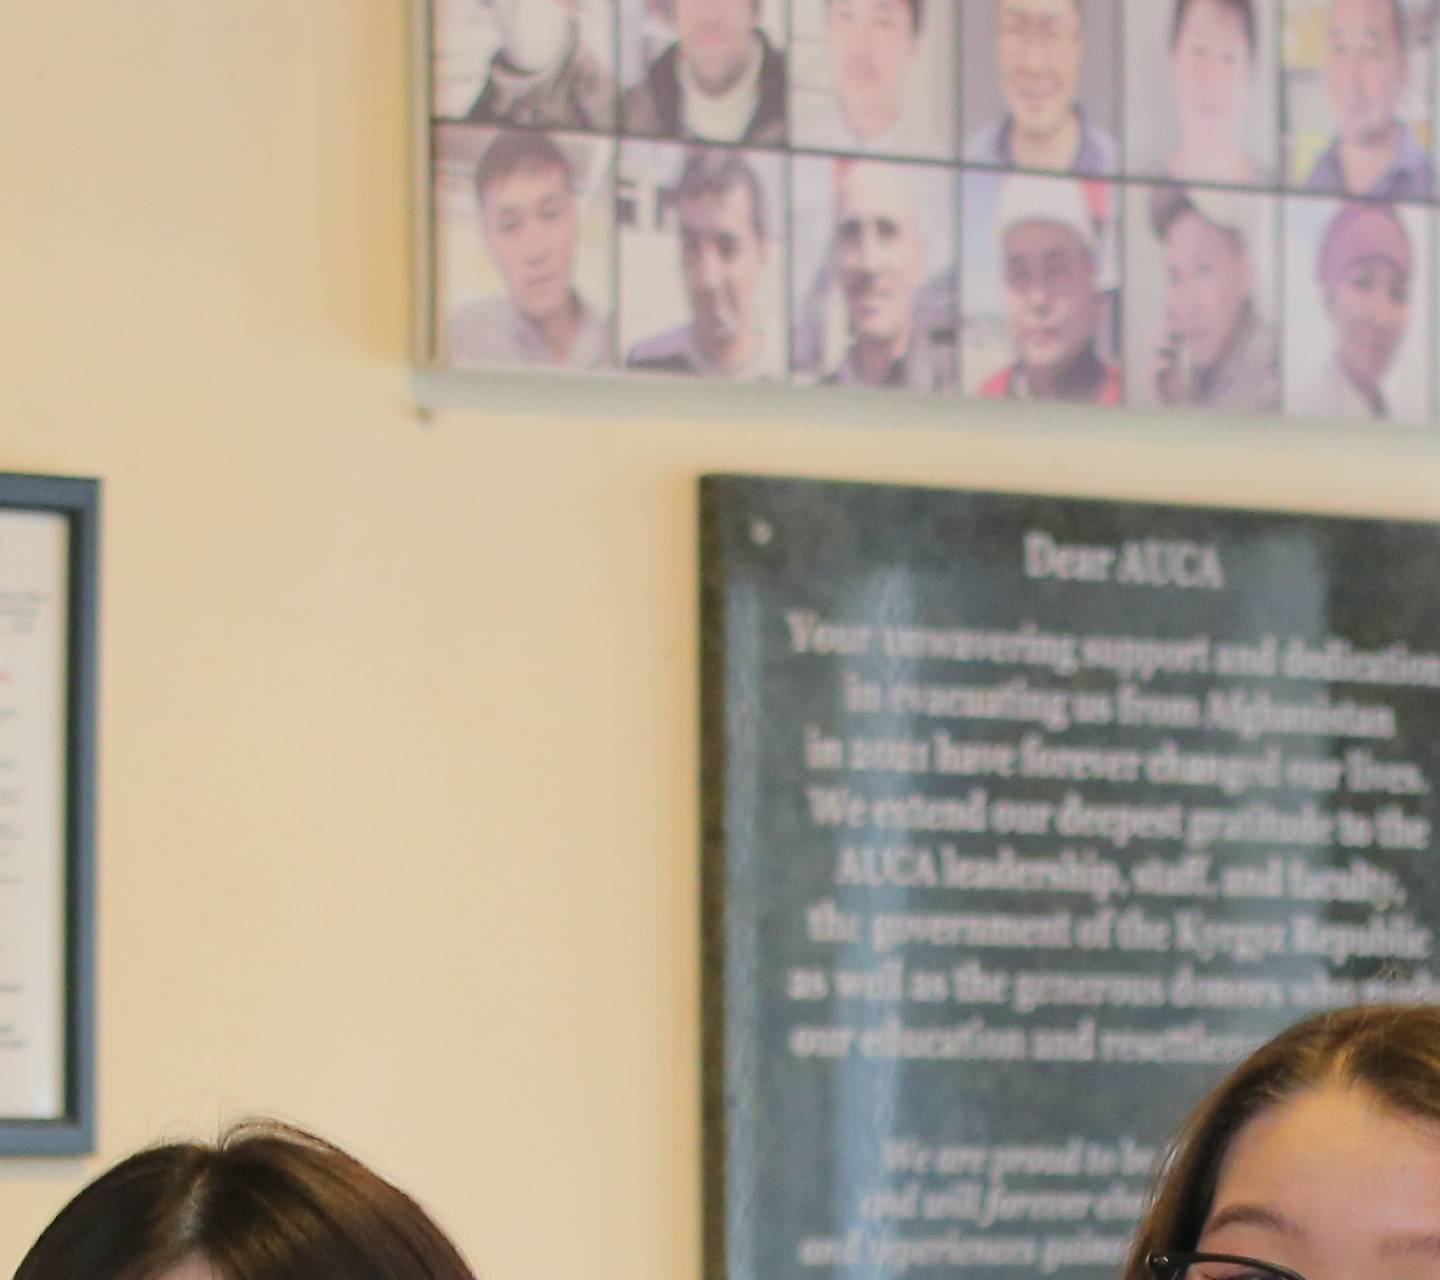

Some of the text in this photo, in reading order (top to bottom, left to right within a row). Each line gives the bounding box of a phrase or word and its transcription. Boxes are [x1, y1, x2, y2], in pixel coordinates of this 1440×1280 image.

[1022, 530, 1227, 590] Dear AUCA
[786, 608, 871, 654] Your
[881, 622, 1080, 676] unwavering
[1081, 632, 1208, 684] support
[1215, 634, 1279, 677] and
[843, 670, 1397, 743] in evacuating us from Afghanistan
[805, 722, 844, 770] in
[932, 730, 1017, 777] have
[1019, 733, 1142, 783] forever
[1145, 738, 1281, 797] changed
[1284, 757, 1344, 793] our
[1344, 748, 1432, 796] lives.
[805, 786, 1432, 850] We extend our deepest gratitude to the
[835, 844, 1408, 912] AUCA leadership, staff, and faculty,
[806, 899, 1433, 966] the government of the Kyrgyz Republic
[787, 968, 829, 1002] as
[832, 955, 904, 1003] well
[910, 970, 951, 1004] as
[953, 958, 1010, 1005] the
[1012, 972, 1166, 1015] generous
[1168, 966, 1286, 1009] donors
[787, 1025, 857, 1060] our
[859, 1013, 1028, 1061] education
[1030, 1016, 1098, 1062] and
[880, 1136, 935, 1174] We
[937, 1145, 987, 1175] are
[987, 1136, 1085, 1184] proud
[1085, 1142, 1118, 1176] to
[859, 1182, 920, 1220] and
[922, 1181, 983, 1220] will
[976, 1183, 1092, 1228] forever
[799, 1227, 860, 1266] and
[864, 1229, 1038, 1275] experiences
